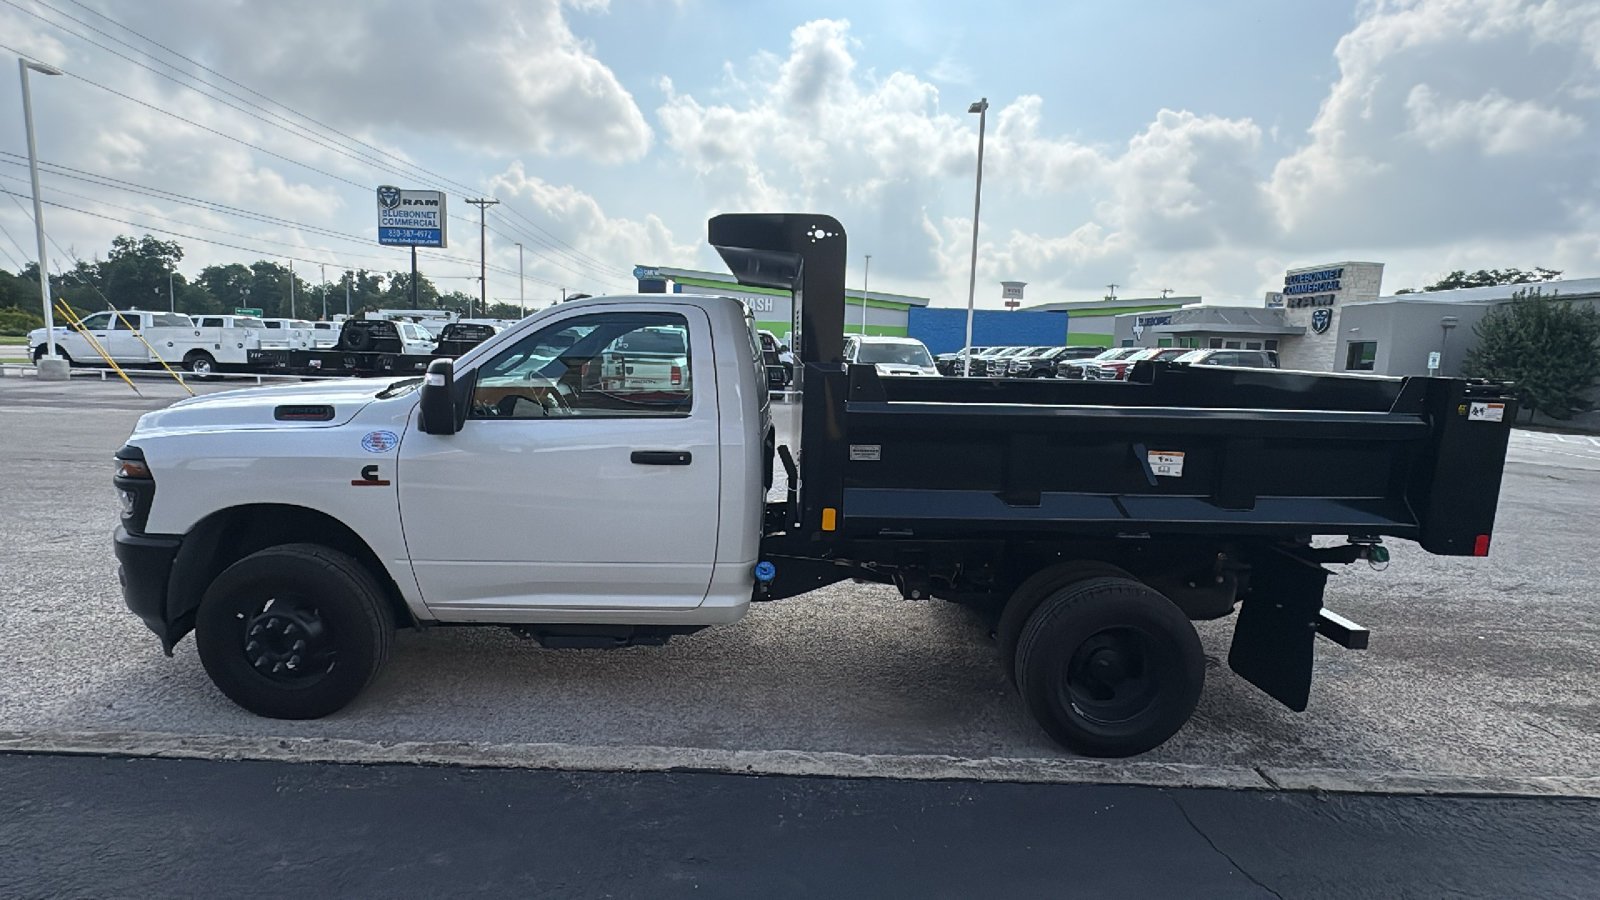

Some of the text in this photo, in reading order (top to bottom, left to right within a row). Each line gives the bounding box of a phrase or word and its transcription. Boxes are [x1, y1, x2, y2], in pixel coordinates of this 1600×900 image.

[382, 210, 437, 219] BLUEBONNET
[382, 218, 438, 227] COMMERCIAL
[1287, 294, 1334, 308] RAM
